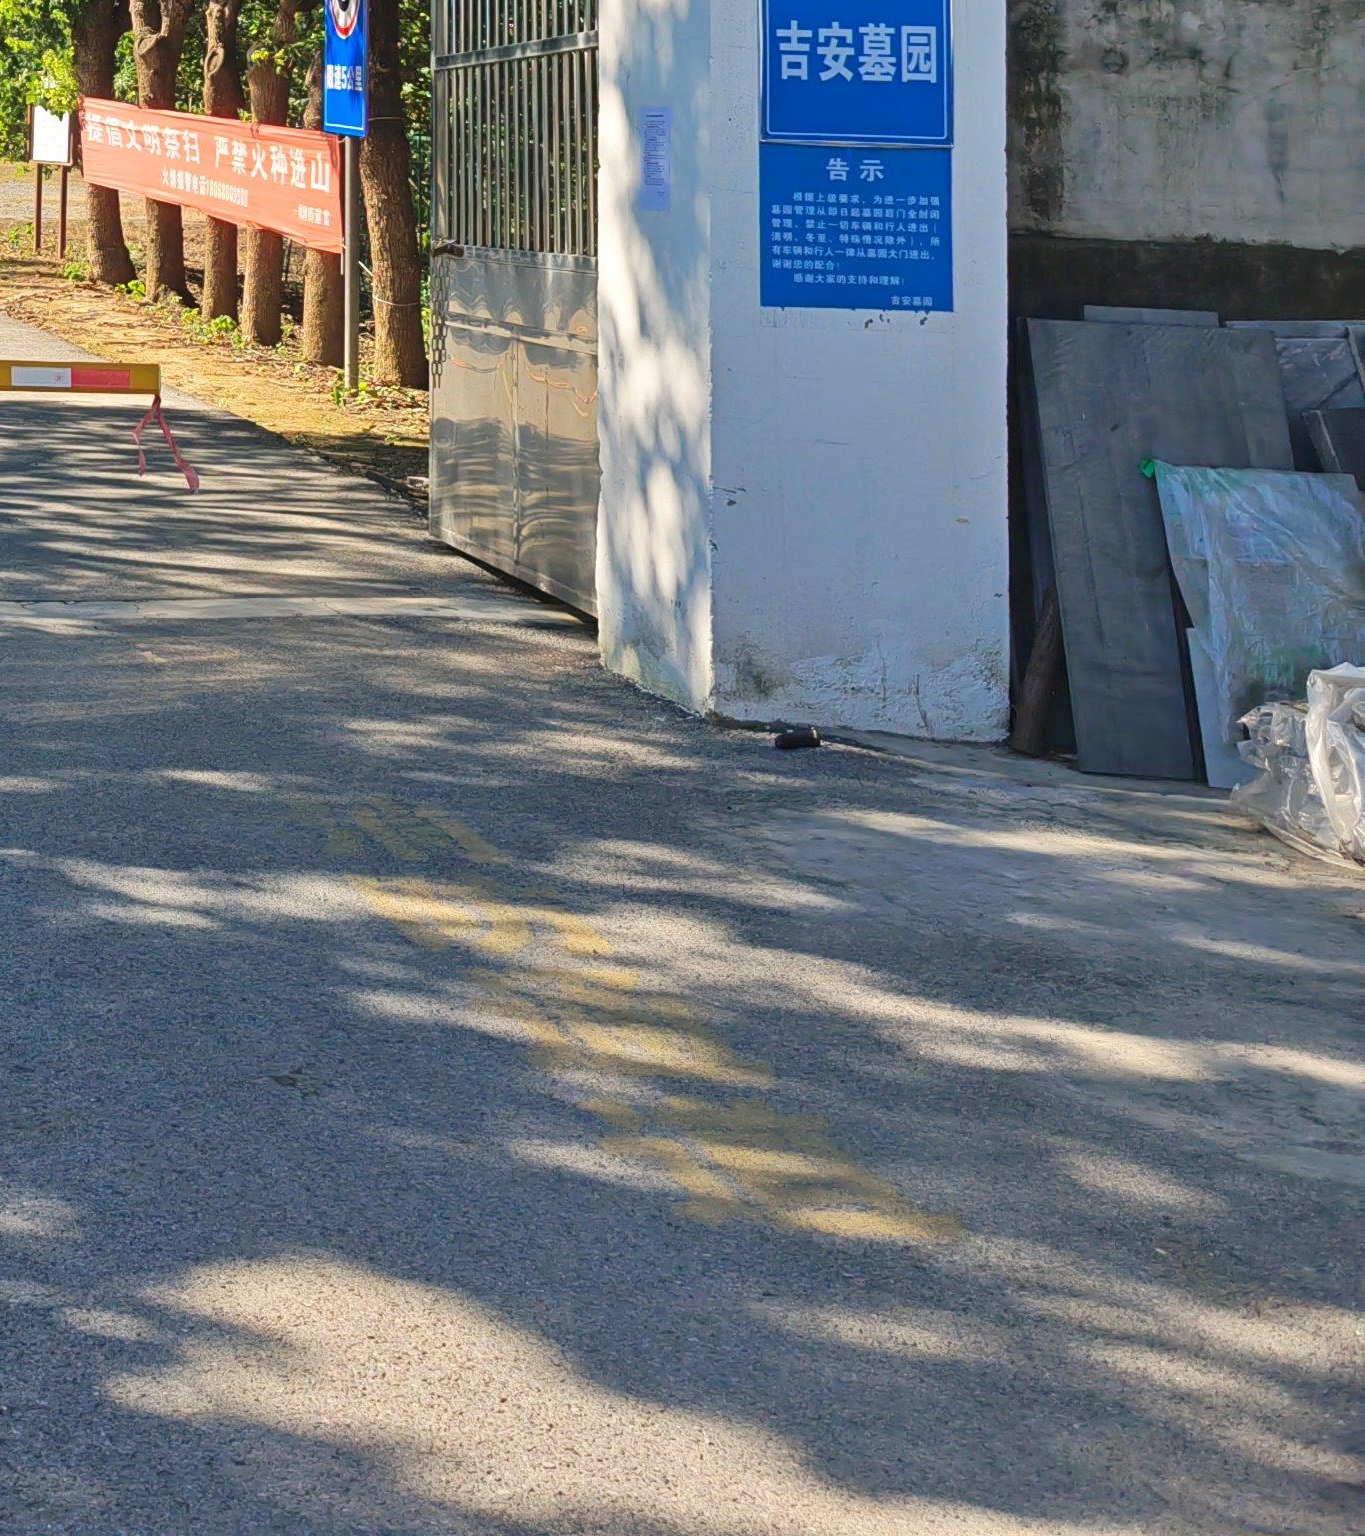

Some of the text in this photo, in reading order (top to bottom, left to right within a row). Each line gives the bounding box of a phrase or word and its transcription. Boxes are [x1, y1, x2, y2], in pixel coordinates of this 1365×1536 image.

[775, 19, 938, 84] 吉安墓园
[326, 63, 363, 92] 限速5公里
[85, 111, 200, 164] 提倡文明祭扫
[214, 135, 330, 193] 严禁火种进山
[825, 158, 885, 182] 告示
[891, 295, 933, 307] 吉安墓园
